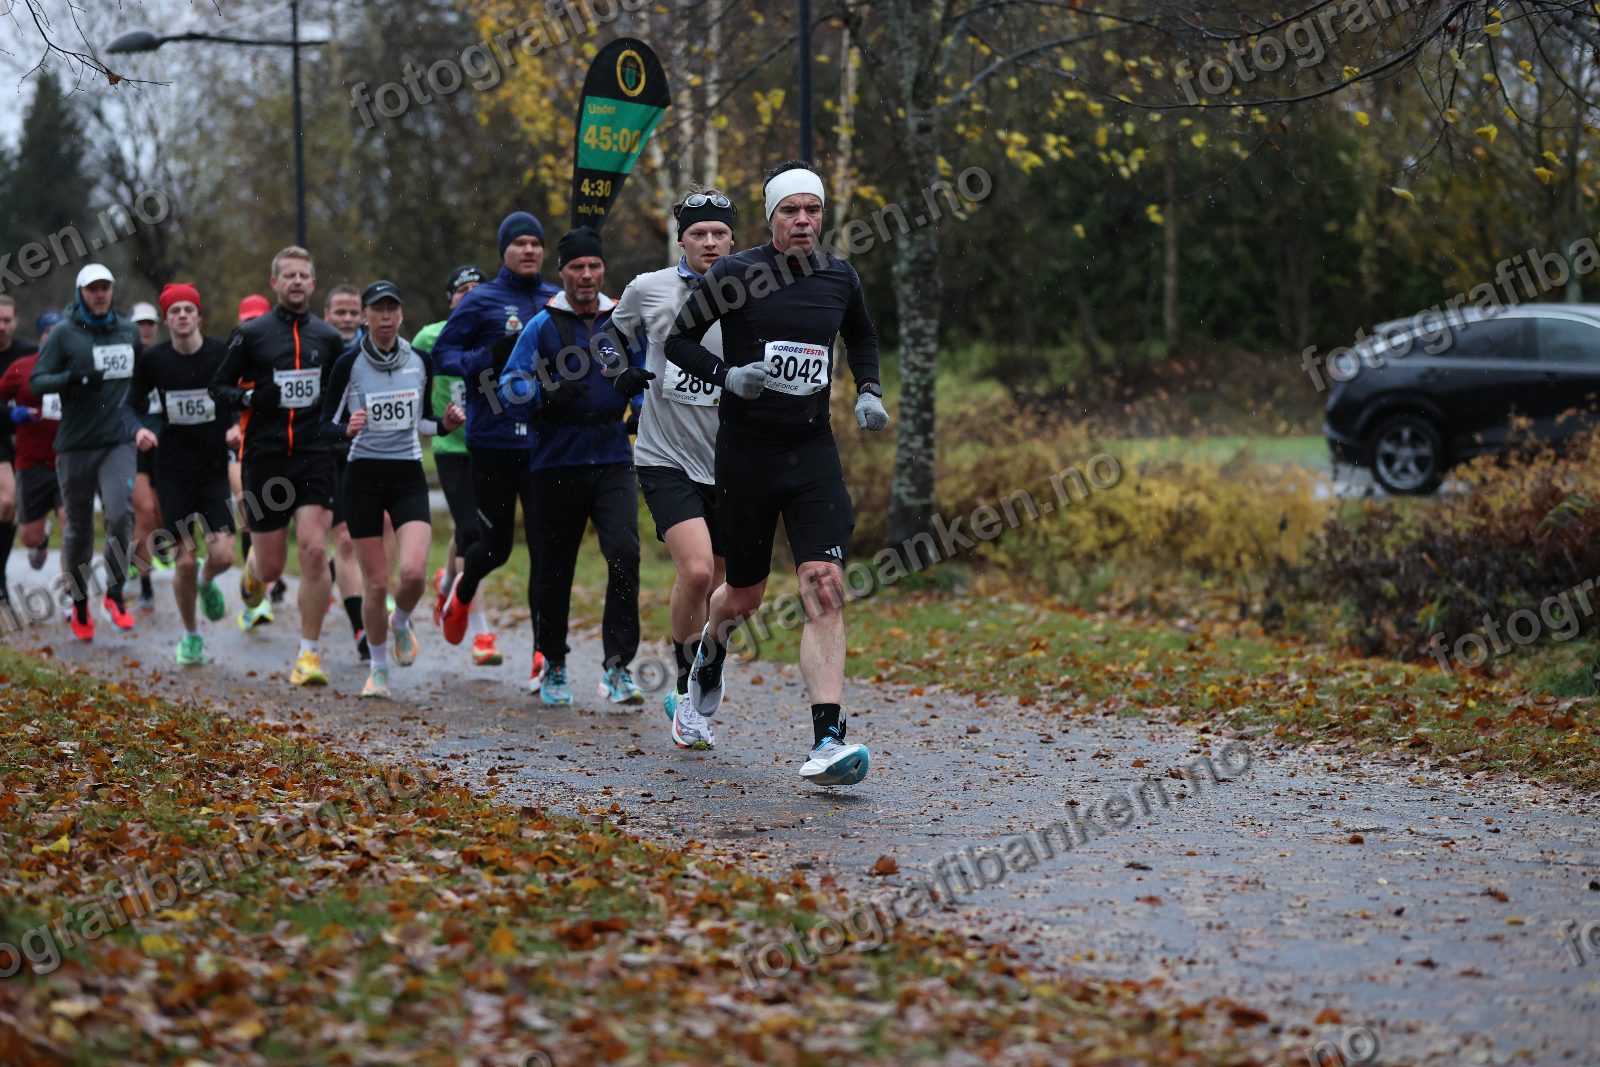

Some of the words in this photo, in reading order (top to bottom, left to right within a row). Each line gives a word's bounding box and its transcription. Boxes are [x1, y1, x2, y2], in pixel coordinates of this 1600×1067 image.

[588, 103, 616, 115] Under
[583, 124, 642, 154] 45:00
[580, 178, 612, 197] 4:30
[103, 354, 127, 371] 562
[768, 354, 823, 385] 3042
[284, 380, 314, 398] 385
[674, 369, 715, 396] 280
[176, 399, 205, 416] 165
[371, 400, 413, 421] 9361
